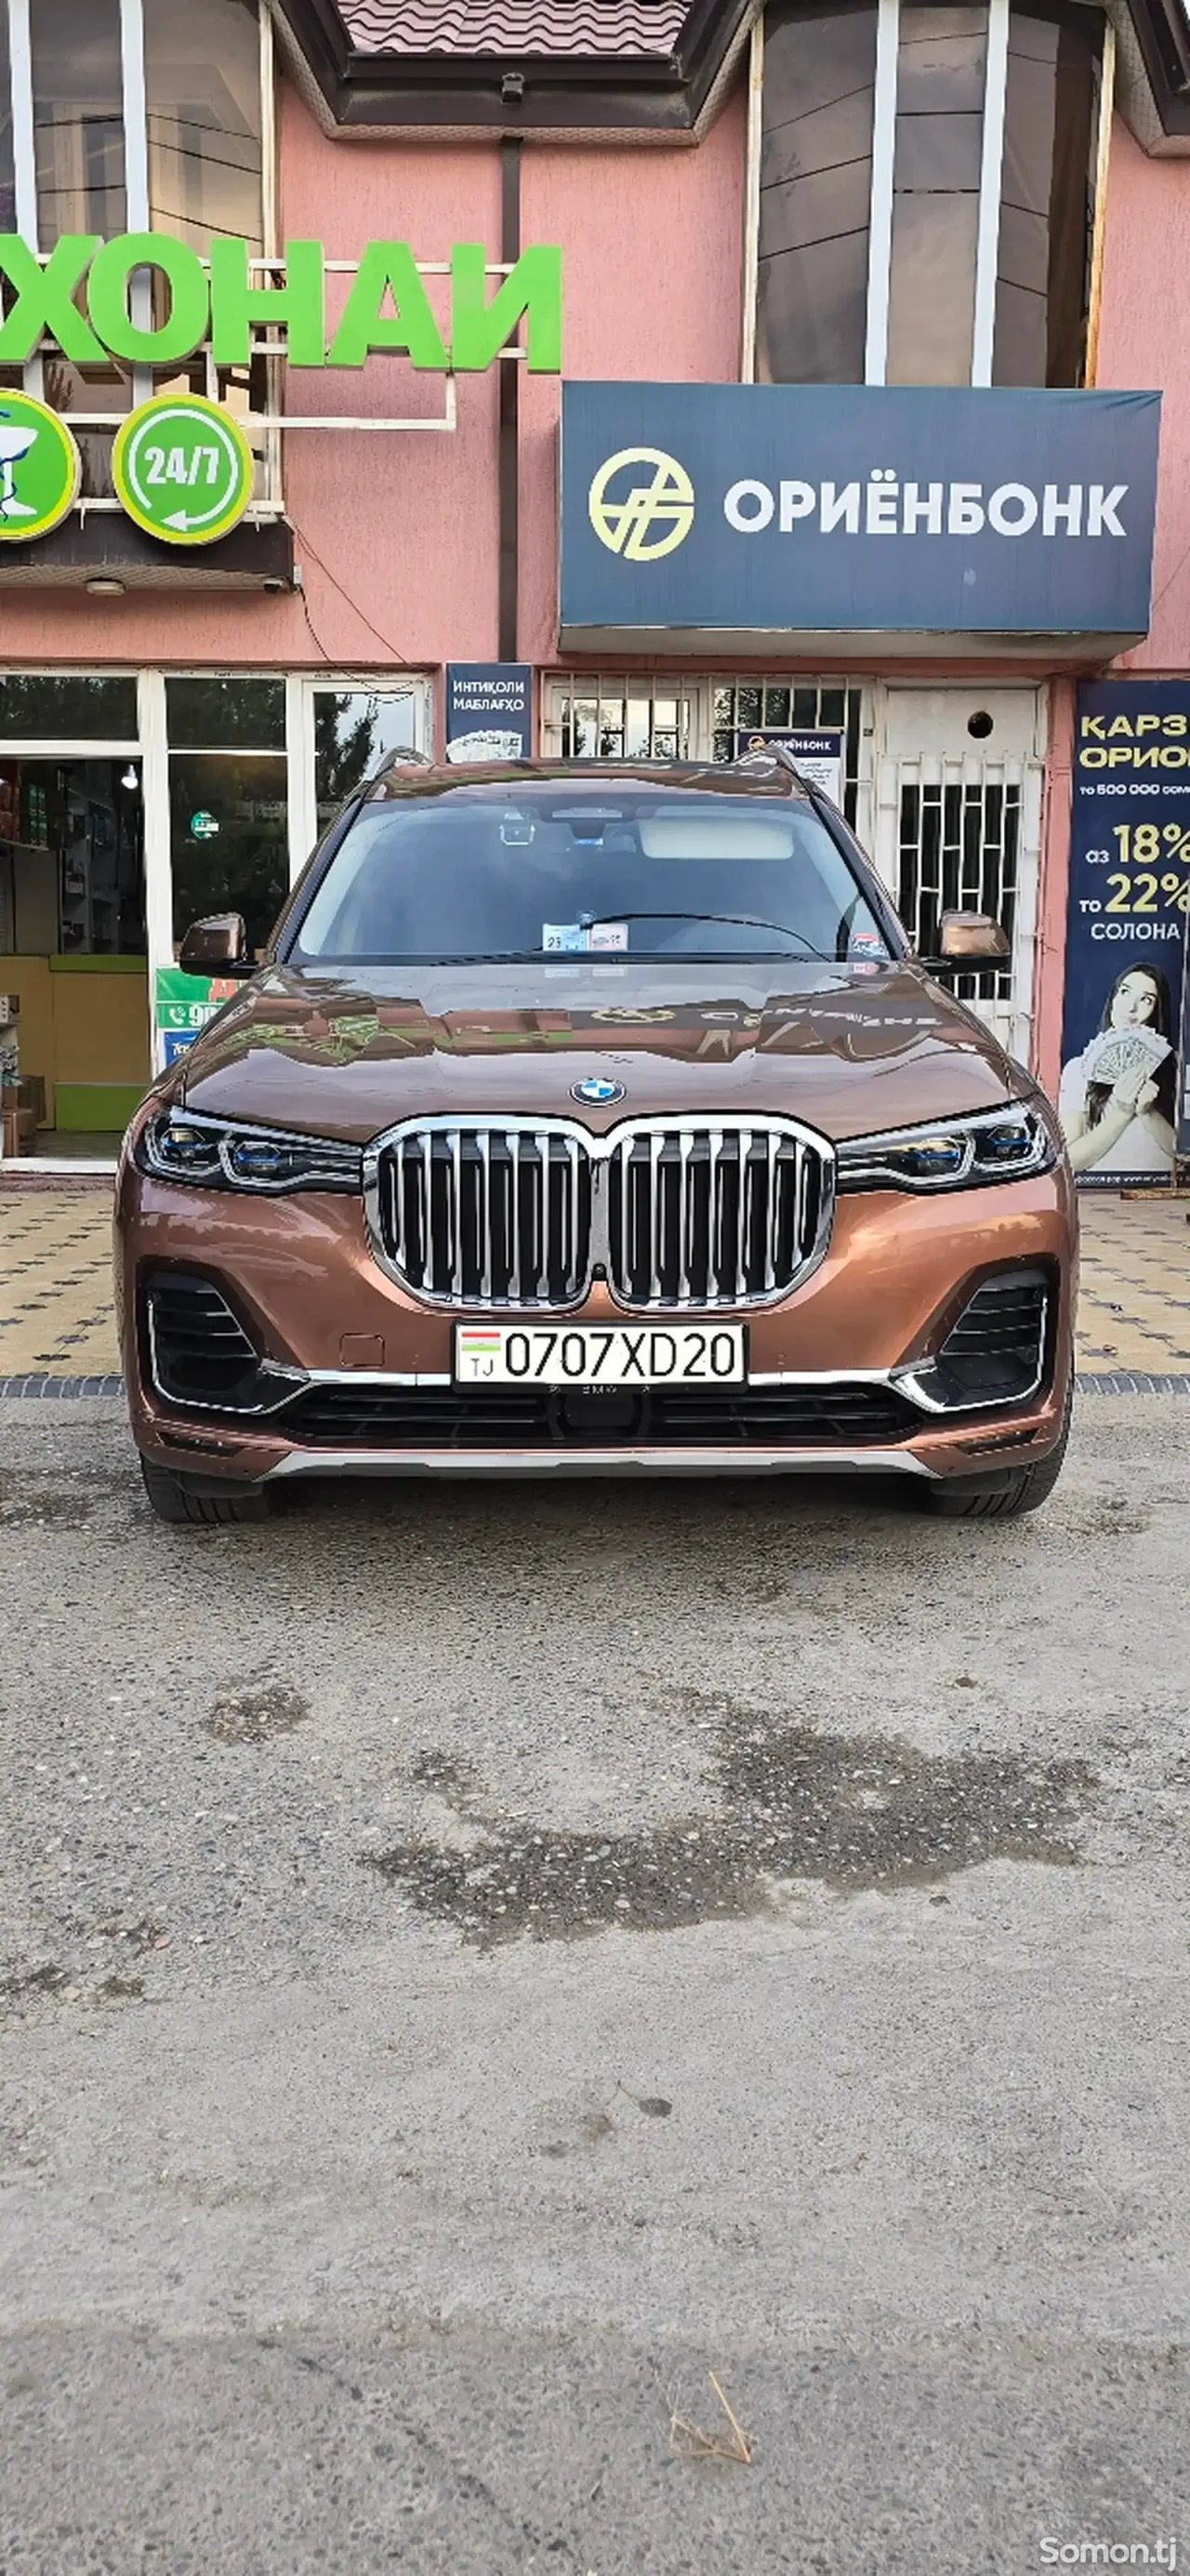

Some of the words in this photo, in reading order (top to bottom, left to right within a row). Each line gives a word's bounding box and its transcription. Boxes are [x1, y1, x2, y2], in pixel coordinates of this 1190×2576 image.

[144, 446, 220, 485] 24/7
[723, 469, 1130, 537] ОРИЁНБОНК
[1080, 714, 1188, 741] ҚАРЗ
[1078, 746, 1190, 769] ОРИО
[1079, 787, 1094, 795] то
[1096, 784, 1125, 795] 500
[1129, 784, 1160, 795] 000
[1085, 850, 1110, 864] аз
[1113, 822, 1190, 864] 18%
[1079, 899, 1102, 913] то
[1104, 872, 1189, 913] 22%
[1091, 923, 1181, 940] СОЛОНА
[470, 1358, 494, 1376] TJ
[505, 1333, 735, 1377] 0707XD20
